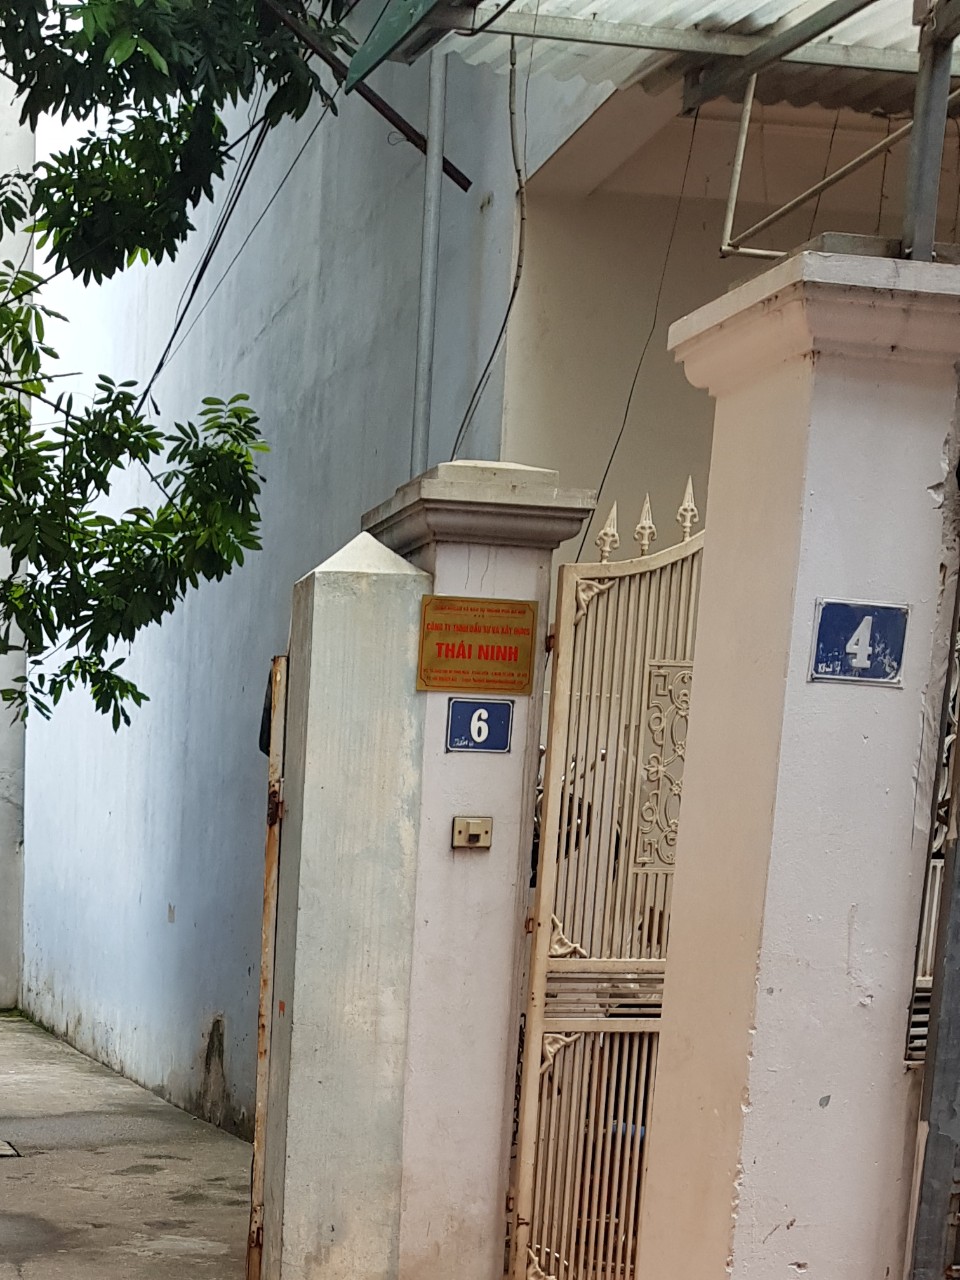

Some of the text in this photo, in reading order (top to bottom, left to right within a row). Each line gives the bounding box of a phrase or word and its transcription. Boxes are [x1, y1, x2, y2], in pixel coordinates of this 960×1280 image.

[436, 640, 519, 662] THÁI NINH
[846, 616, 873, 669] 4
[470, 708, 489, 743] 6
